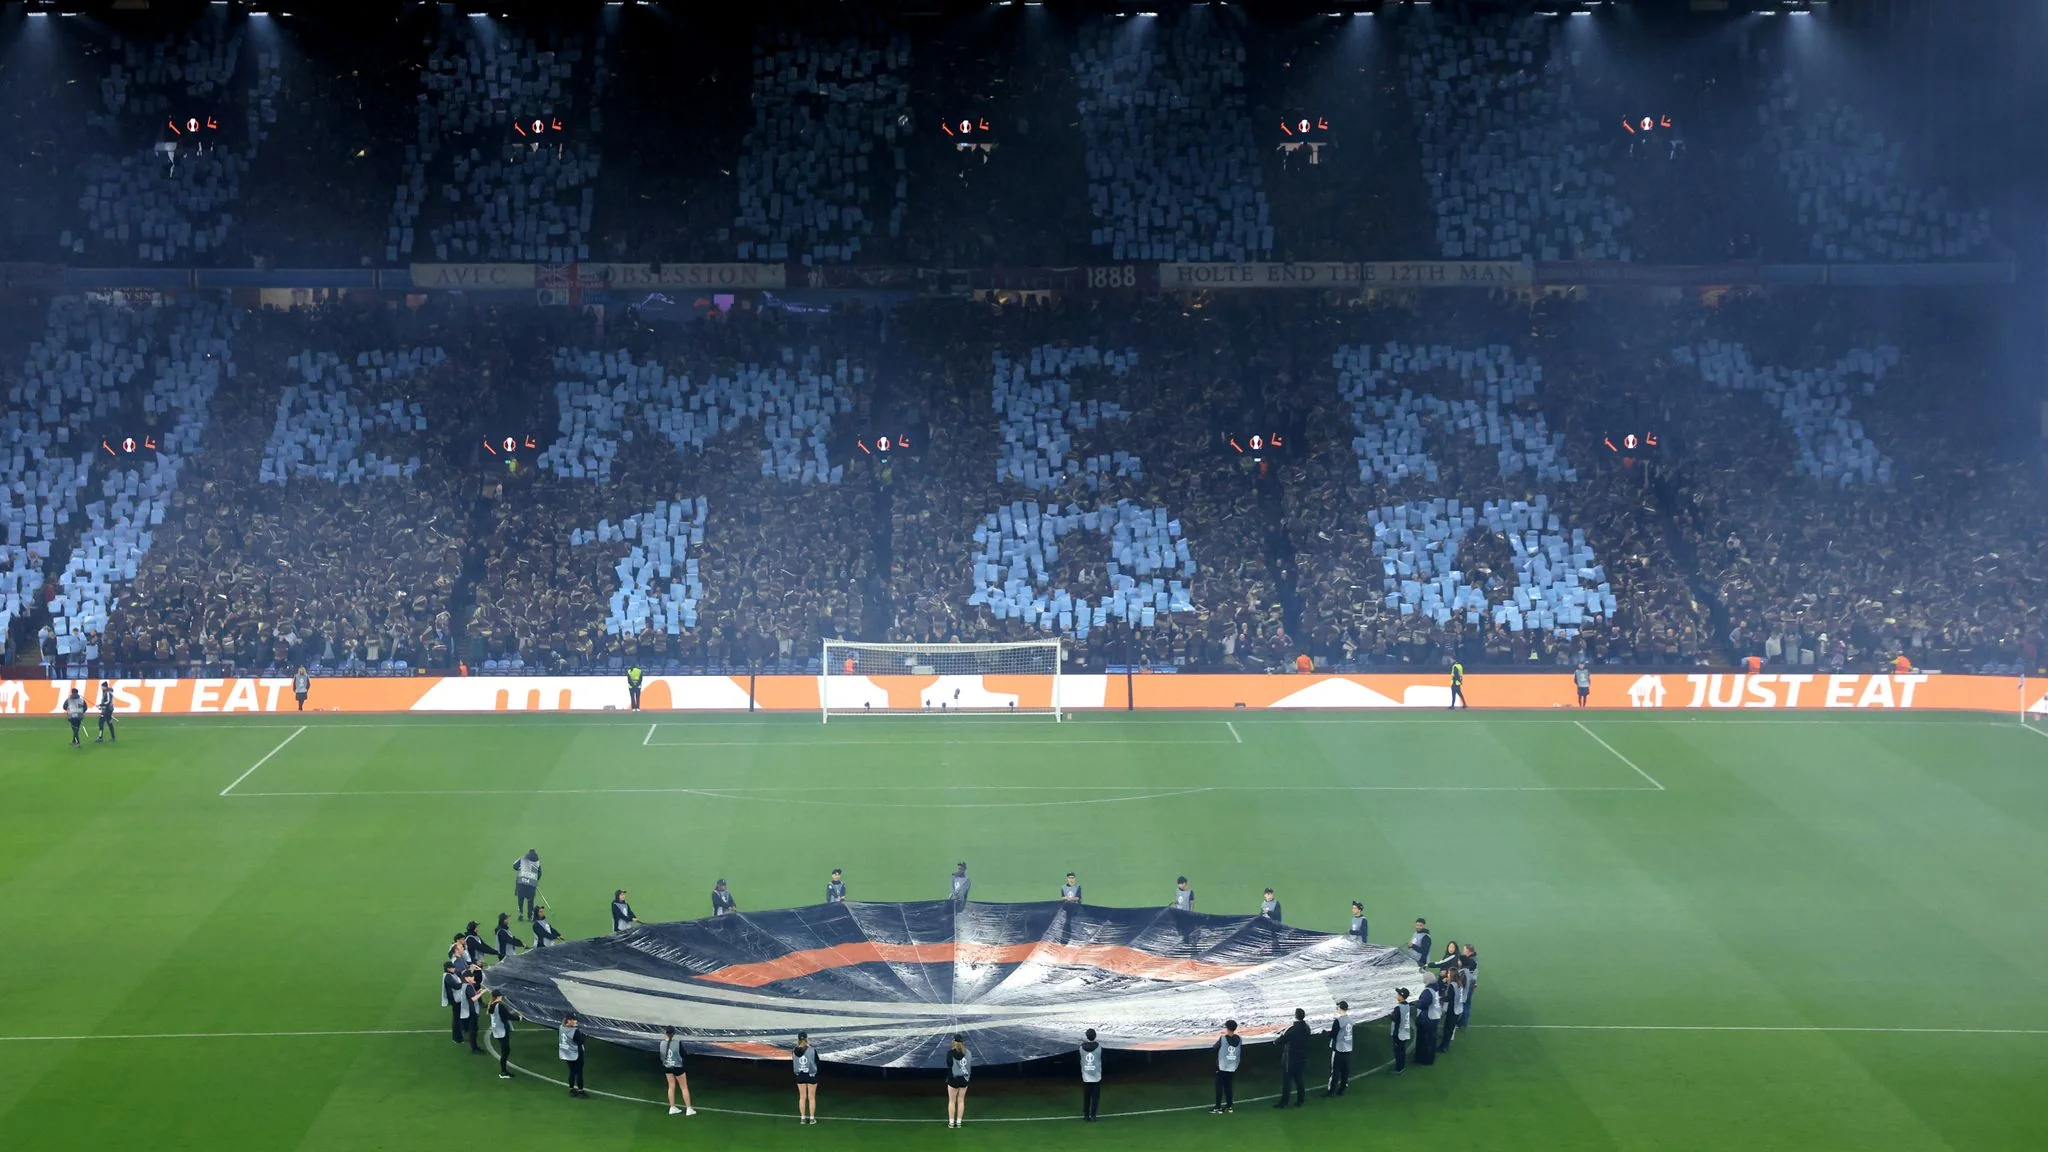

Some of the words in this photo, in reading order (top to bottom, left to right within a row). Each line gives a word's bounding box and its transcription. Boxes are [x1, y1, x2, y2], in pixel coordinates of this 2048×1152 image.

[436, 266, 507, 285] AVFC
[1086, 265, 1136, 288] 1888
[1177, 266, 1254, 283] HOLTE
[1267, 265, 1316, 282] END
[1329, 264, 1376, 282] THE
[1390, 264, 1446, 282] 12TH
[1458, 264, 1515, 282] MAN
[50, 679, 177, 712] JUST
[190, 678, 293, 712] EAT
[1686, 674, 1812, 708] JUST
[1825, 674, 1928, 708] EAT
